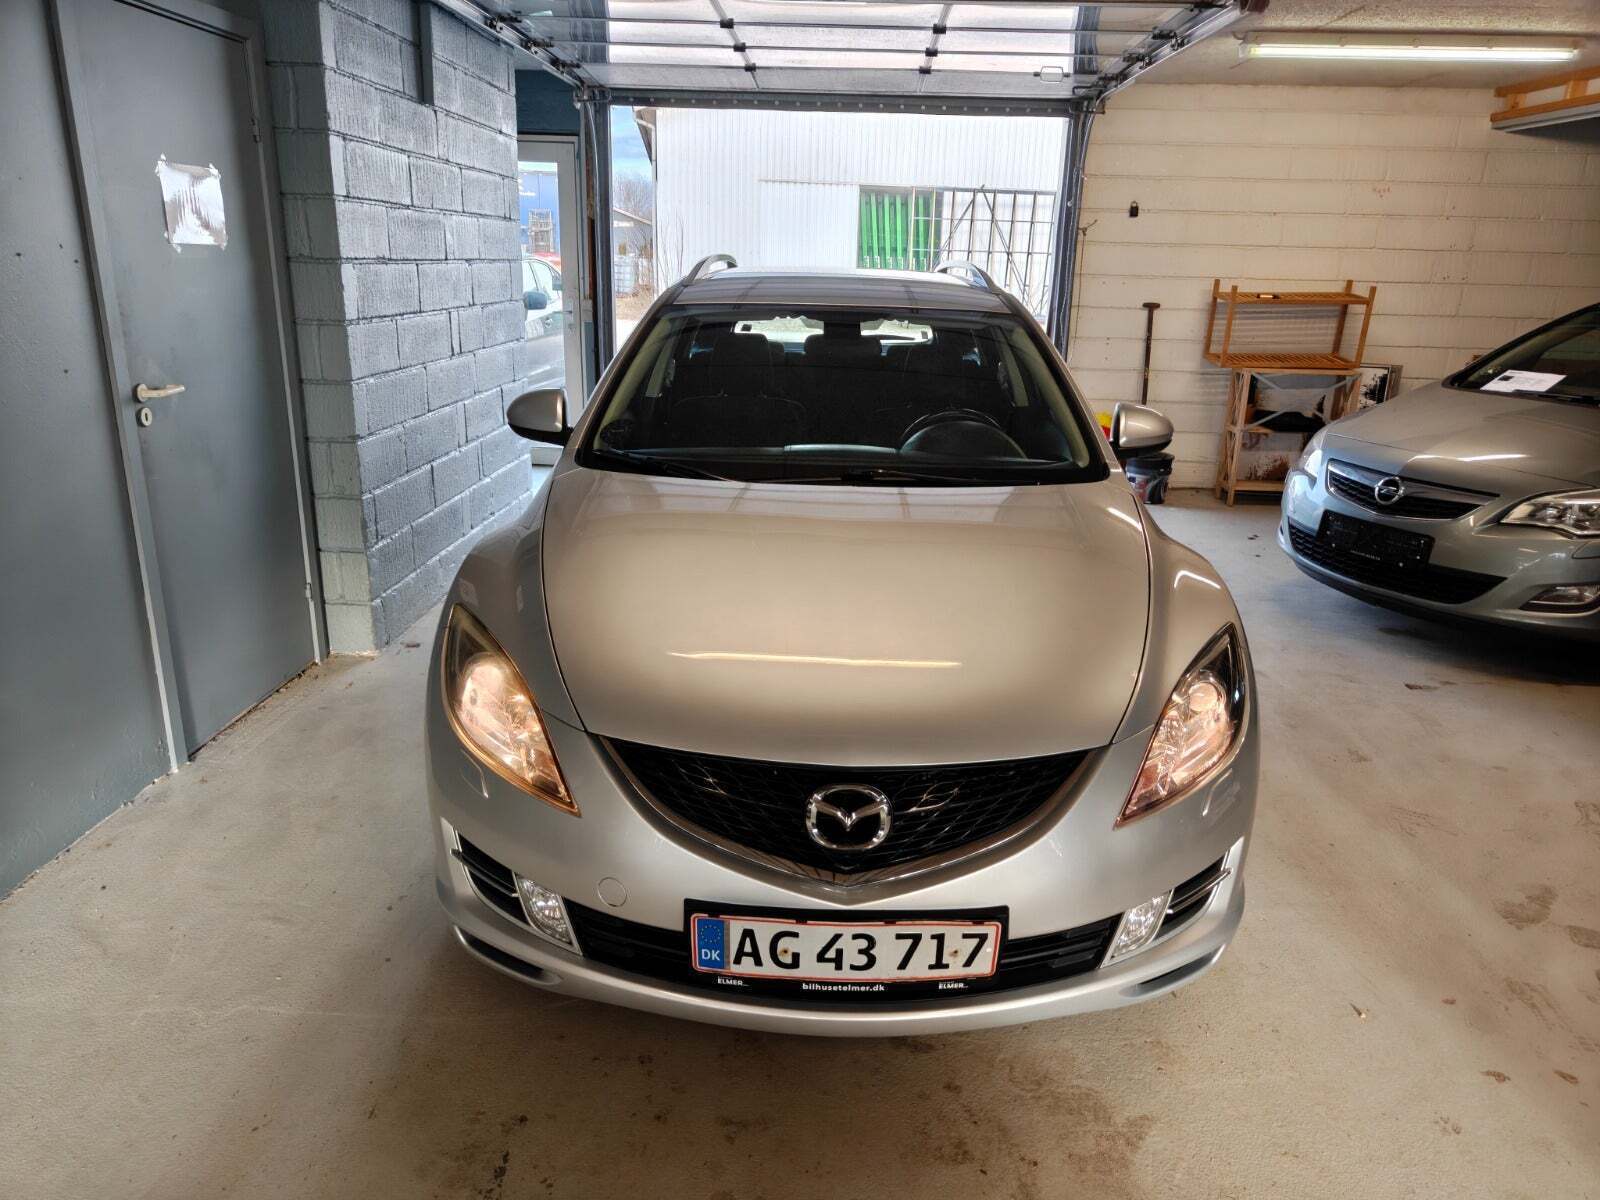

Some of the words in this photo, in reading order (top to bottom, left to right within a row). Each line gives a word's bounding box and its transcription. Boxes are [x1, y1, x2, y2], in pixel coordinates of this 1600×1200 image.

[701, 949, 721, 961] DK
[733, 928, 801, 970] AG
[816, 933, 877, 971] 43
[895, 932, 989, 970] 717
[802, 983, 885, 992] bilhusetelmer.dk
